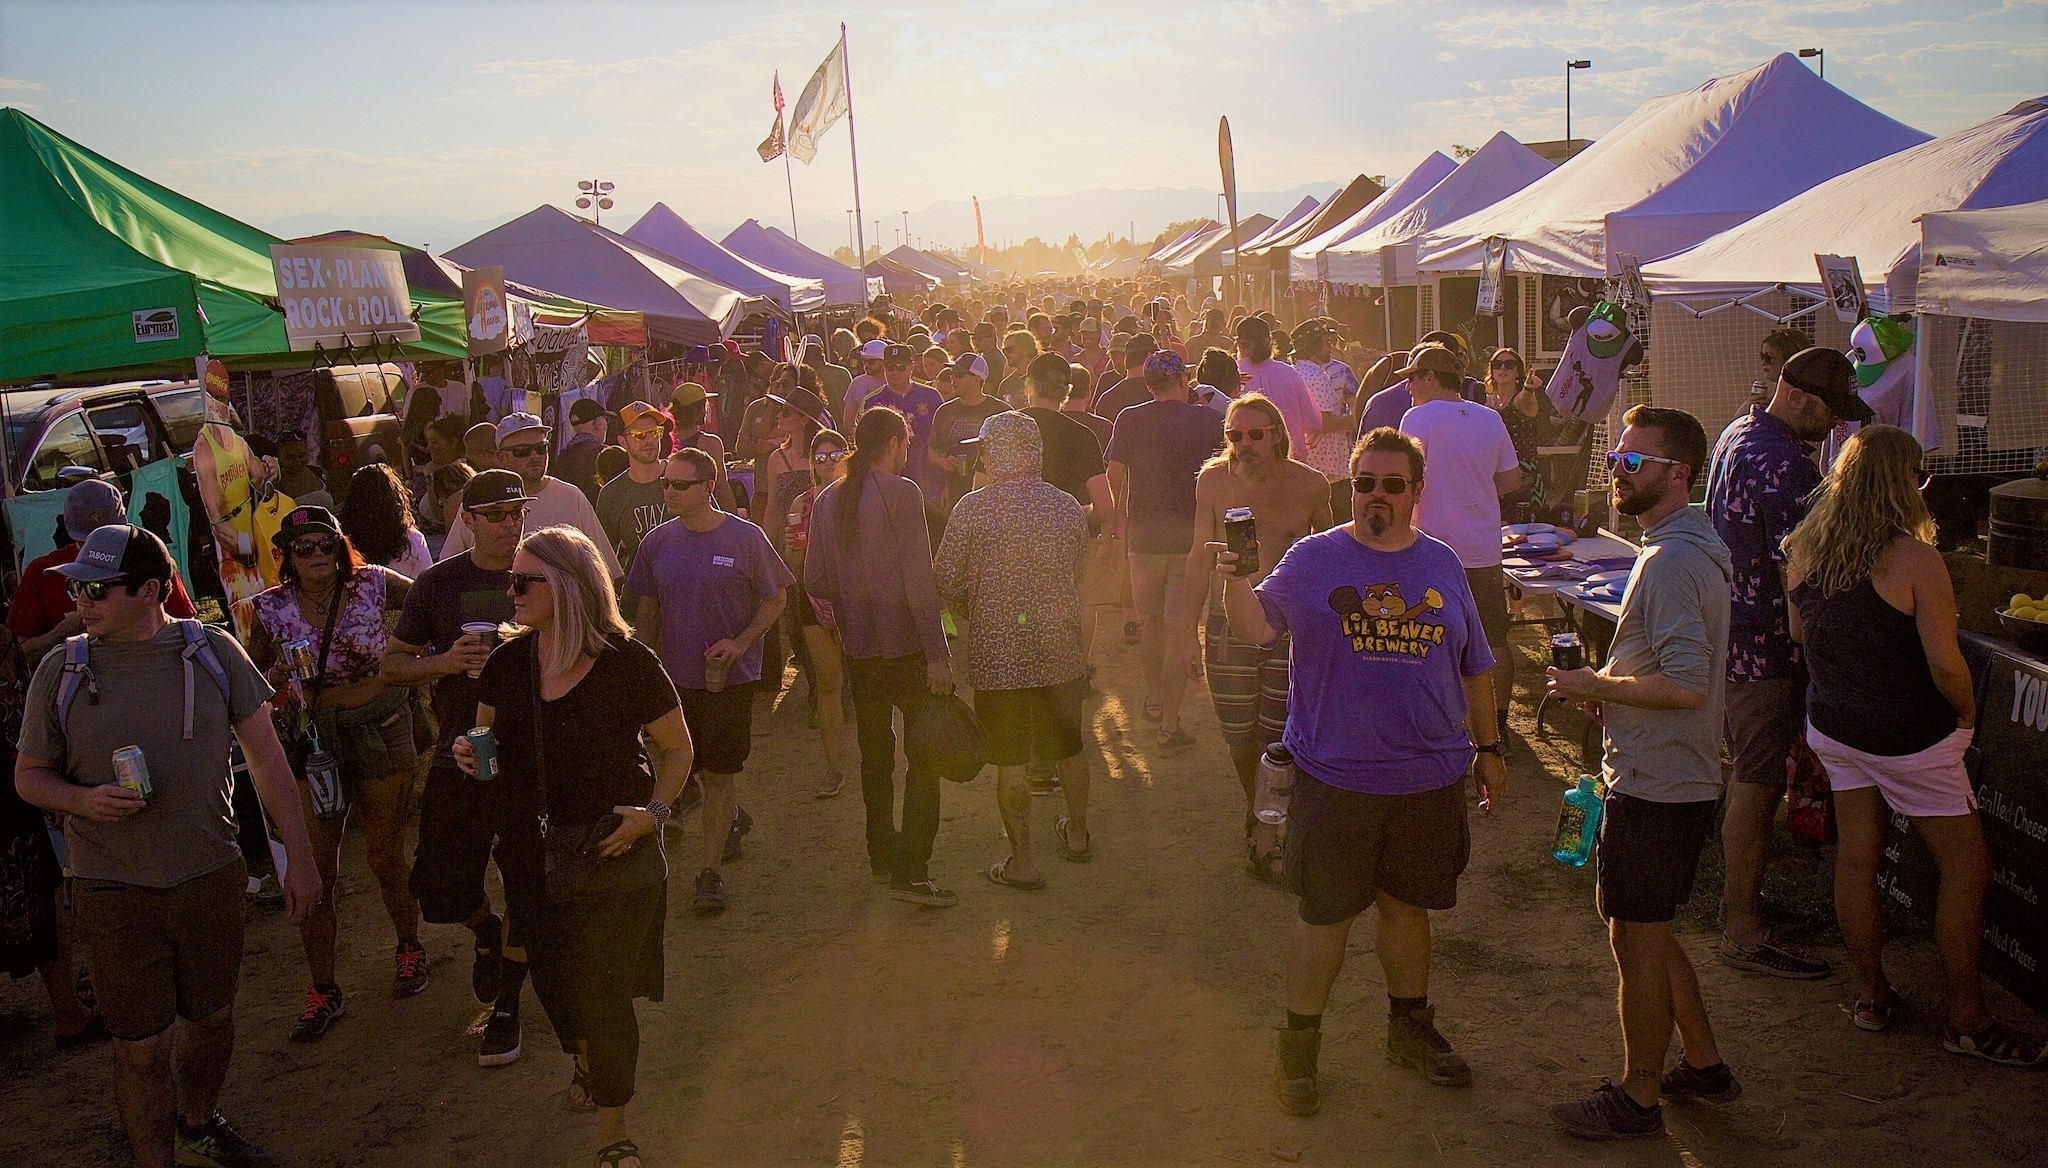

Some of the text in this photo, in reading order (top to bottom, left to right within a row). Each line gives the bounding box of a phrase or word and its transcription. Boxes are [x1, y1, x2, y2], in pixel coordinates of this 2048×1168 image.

[279, 257, 404, 290] SEX PLANTS
[135, 321, 175, 336] Eurmax
[284, 297, 346, 330] ROCK
[348, 303, 355, 321] &
[633, 502, 666, 534] STAY
[88, 550, 116, 563] TABOOT
[1352, 635, 1431, 659] BREWERY
[1375, 618, 1446, 647] BEAVER
[1983, 918, 2009, 954] rilled
